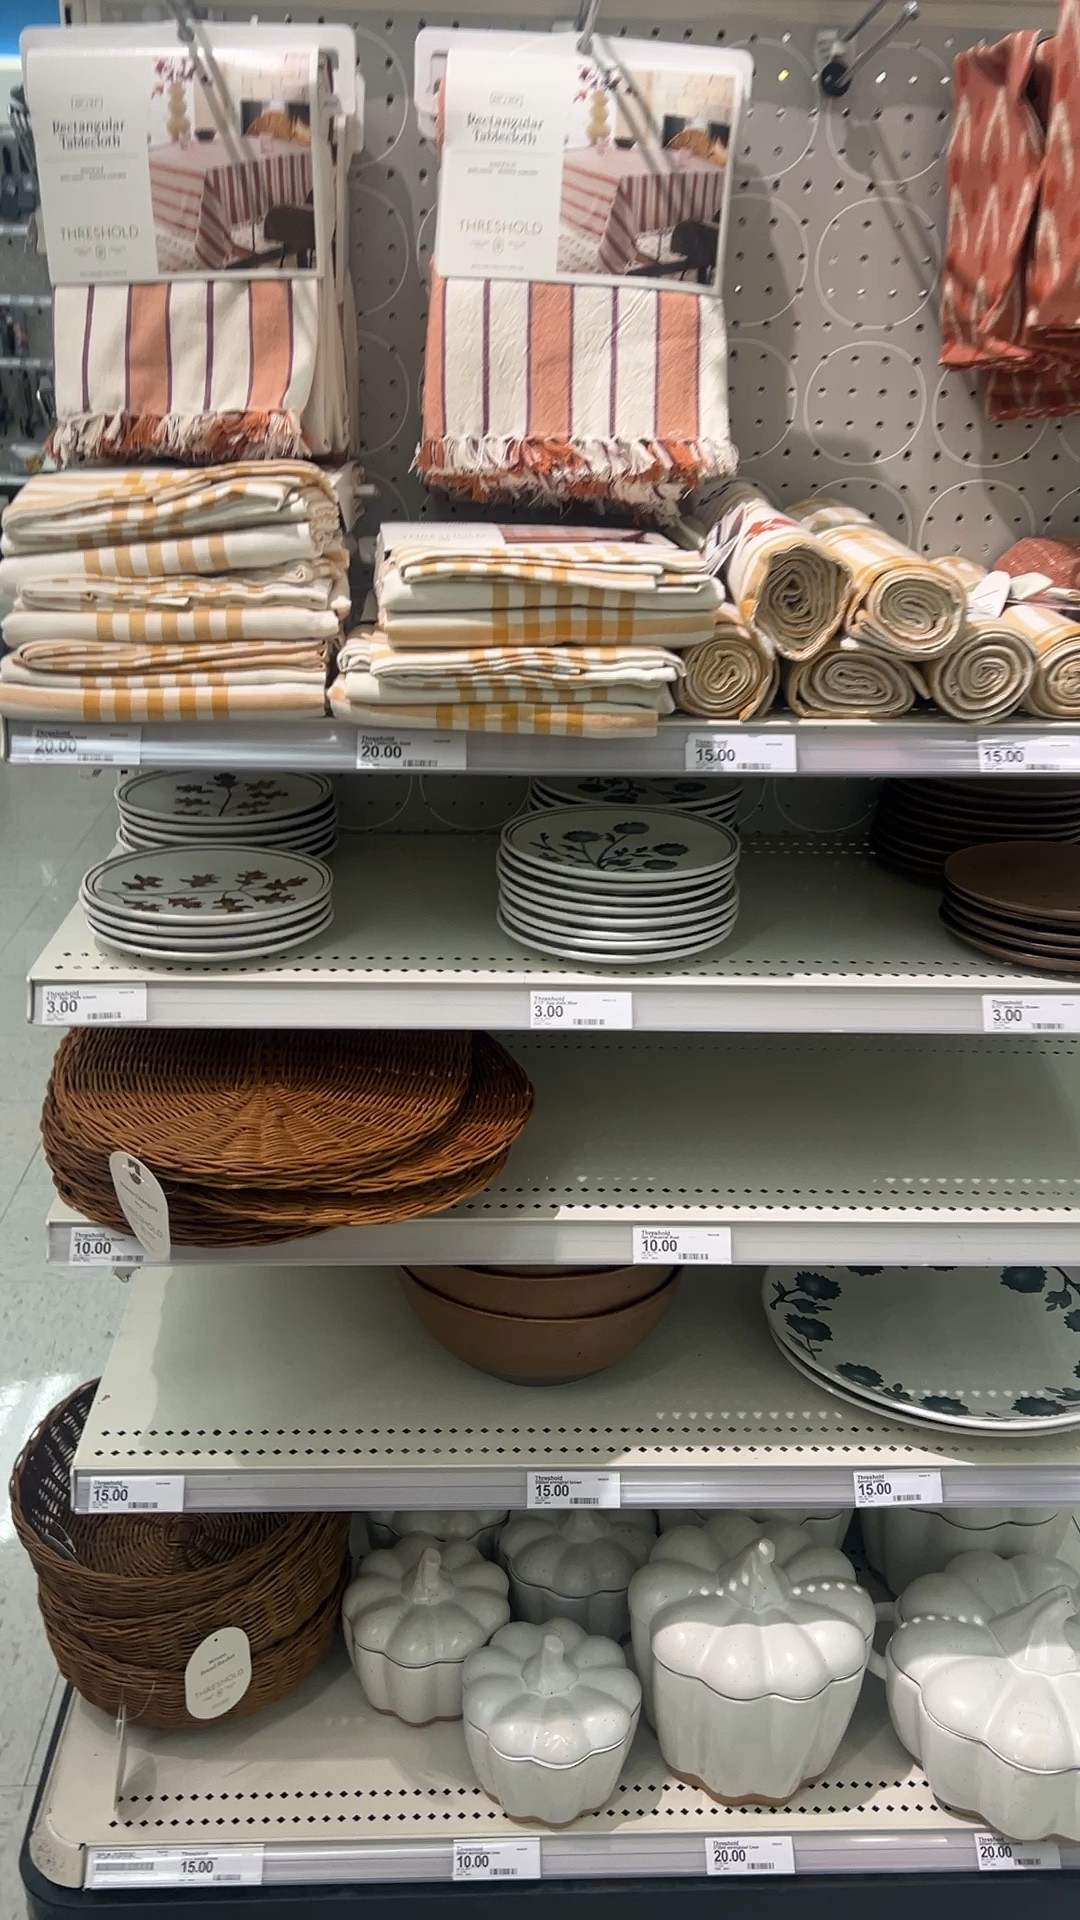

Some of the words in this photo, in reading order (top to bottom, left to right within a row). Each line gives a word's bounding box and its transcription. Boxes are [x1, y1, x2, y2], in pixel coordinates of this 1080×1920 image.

[52, 116, 125, 135] Rectangular
[466, 111, 544, 130] Rectangular
[59, 131, 121, 150] Tablecloth
[472, 129, 538, 146] Tablecloth
[60, 224, 139, 241] THRESHOLD
[458, 217, 544, 236] THRESHOLD
[35, 740, 77, 754] 20.00
[361, 745, 402, 759] 20.00
[695, 749, 736, 762] 15.00
[984, 750, 1025, 762] 15.00
[47, 1000, 78, 1013] 3.00
[534, 1005, 564, 1018] 3.00
[992, 1009, 1023, 1022] 3.00
[74, 1242, 112, 1254] 10.00
[642, 1240, 678, 1252] 10.00
[93, 1489, 128, 1501] 15.00
[535, 1485, 570, 1497] 15.00
[858, 1482, 892, 1495] 15.00
[714, 1850, 746, 1862] 20.00
[980, 1846, 1013, 1858] 20.00
[181, 1861, 214, 1873] 15.00
[457, 1855, 489, 1868] 10.00
